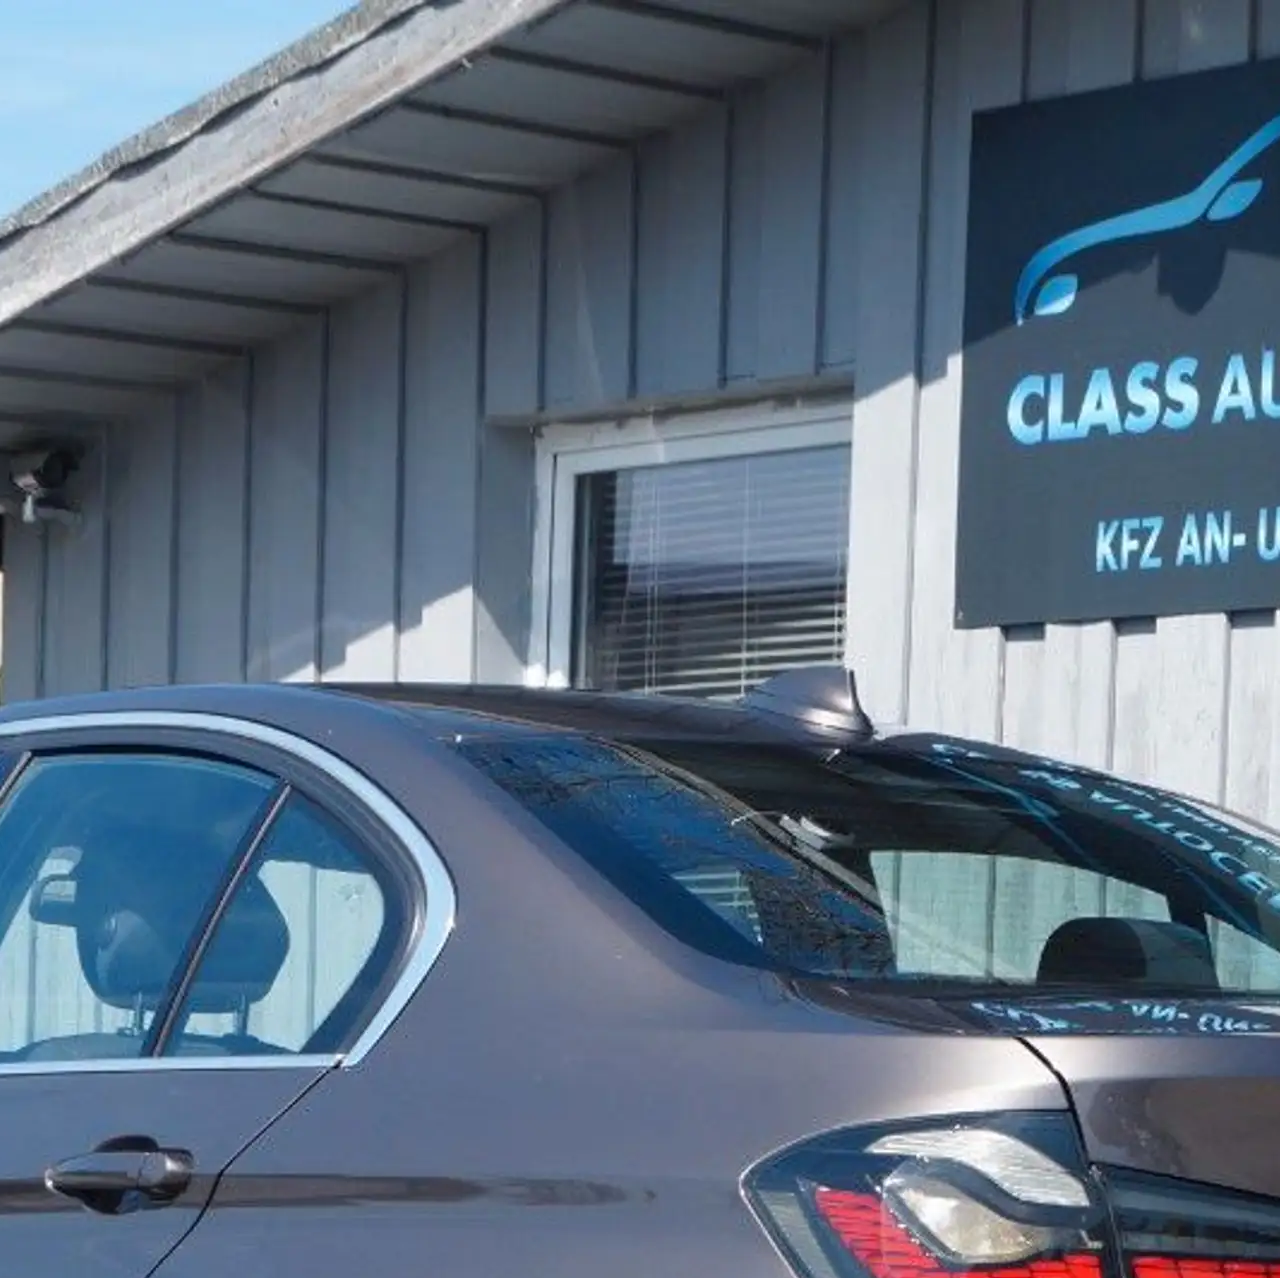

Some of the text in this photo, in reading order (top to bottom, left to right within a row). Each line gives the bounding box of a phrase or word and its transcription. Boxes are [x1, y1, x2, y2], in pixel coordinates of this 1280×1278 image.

[1007, 356, 1200, 446] CLASS
[1096, 516, 1164, 572] KFZ
[1176, 513, 1246, 566] AN-
